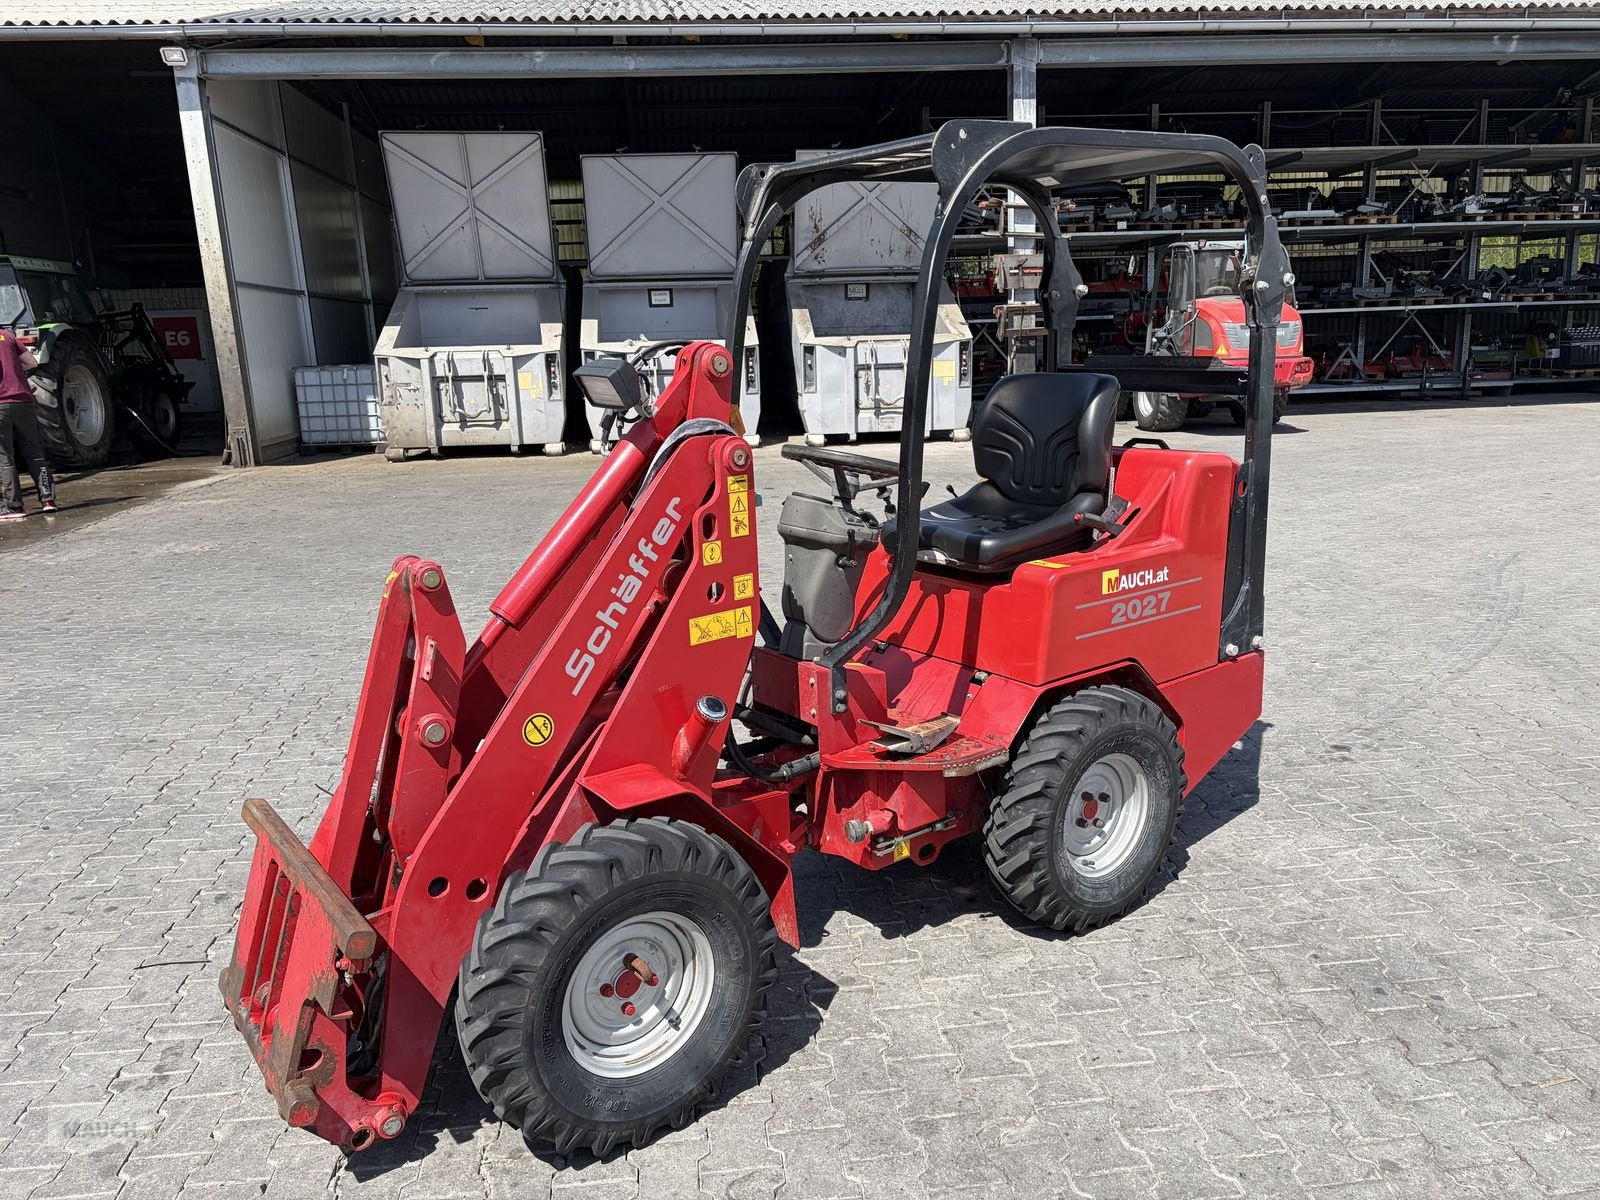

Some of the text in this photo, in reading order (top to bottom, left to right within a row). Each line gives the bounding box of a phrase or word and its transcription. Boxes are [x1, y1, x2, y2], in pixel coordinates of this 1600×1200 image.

[164, 330, 190, 346] E6
[1107, 566, 1169, 593] MAUCH.at
[564, 496, 682, 697] Schäffer
[1110, 591, 1171, 625] 2027
